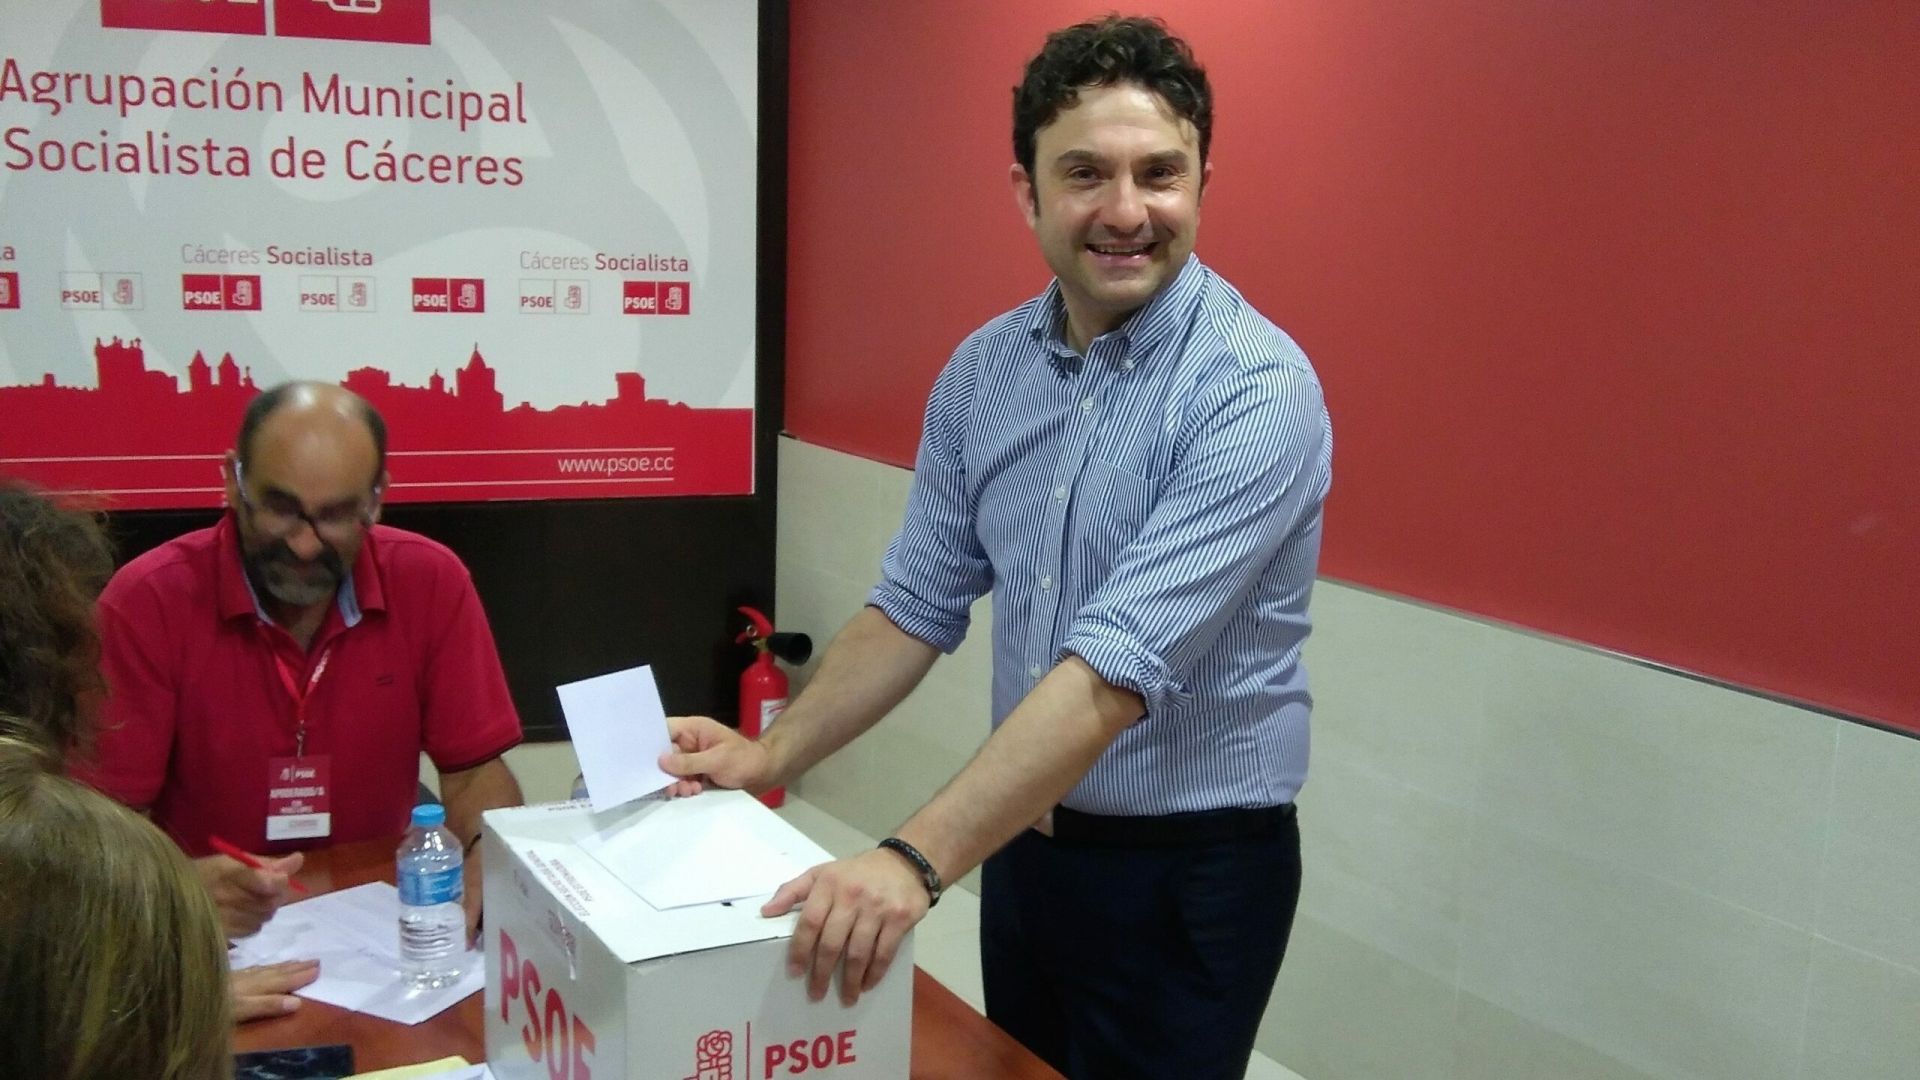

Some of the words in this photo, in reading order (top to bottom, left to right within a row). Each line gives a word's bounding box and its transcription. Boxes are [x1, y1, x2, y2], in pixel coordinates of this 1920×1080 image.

[0, 57, 283, 116] Agrupación
[303, 71, 527, 132] Municipal
[4, 126, 251, 179] Socialista
[270, 136, 326, 181] de
[345, 139, 525, 187] Cáceres
[181, 243, 261, 265] Cáceres
[266, 245, 373, 267] Socialista
[519, 250, 589, 271] Cáceres
[595, 252, 689, 272] Socialista
[62, 290, 100, 304] PSOE
[184, 290, 221, 305] PSOE
[300, 293, 336, 306] PSOE
[413, 293, 447, 307] PSOE
[520, 296, 553, 308] PSOE
[624, 297, 655, 309] PSOE
[557, 456, 674, 477] www.psoe.cc
[765, 1029, 856, 1079] PSOE
